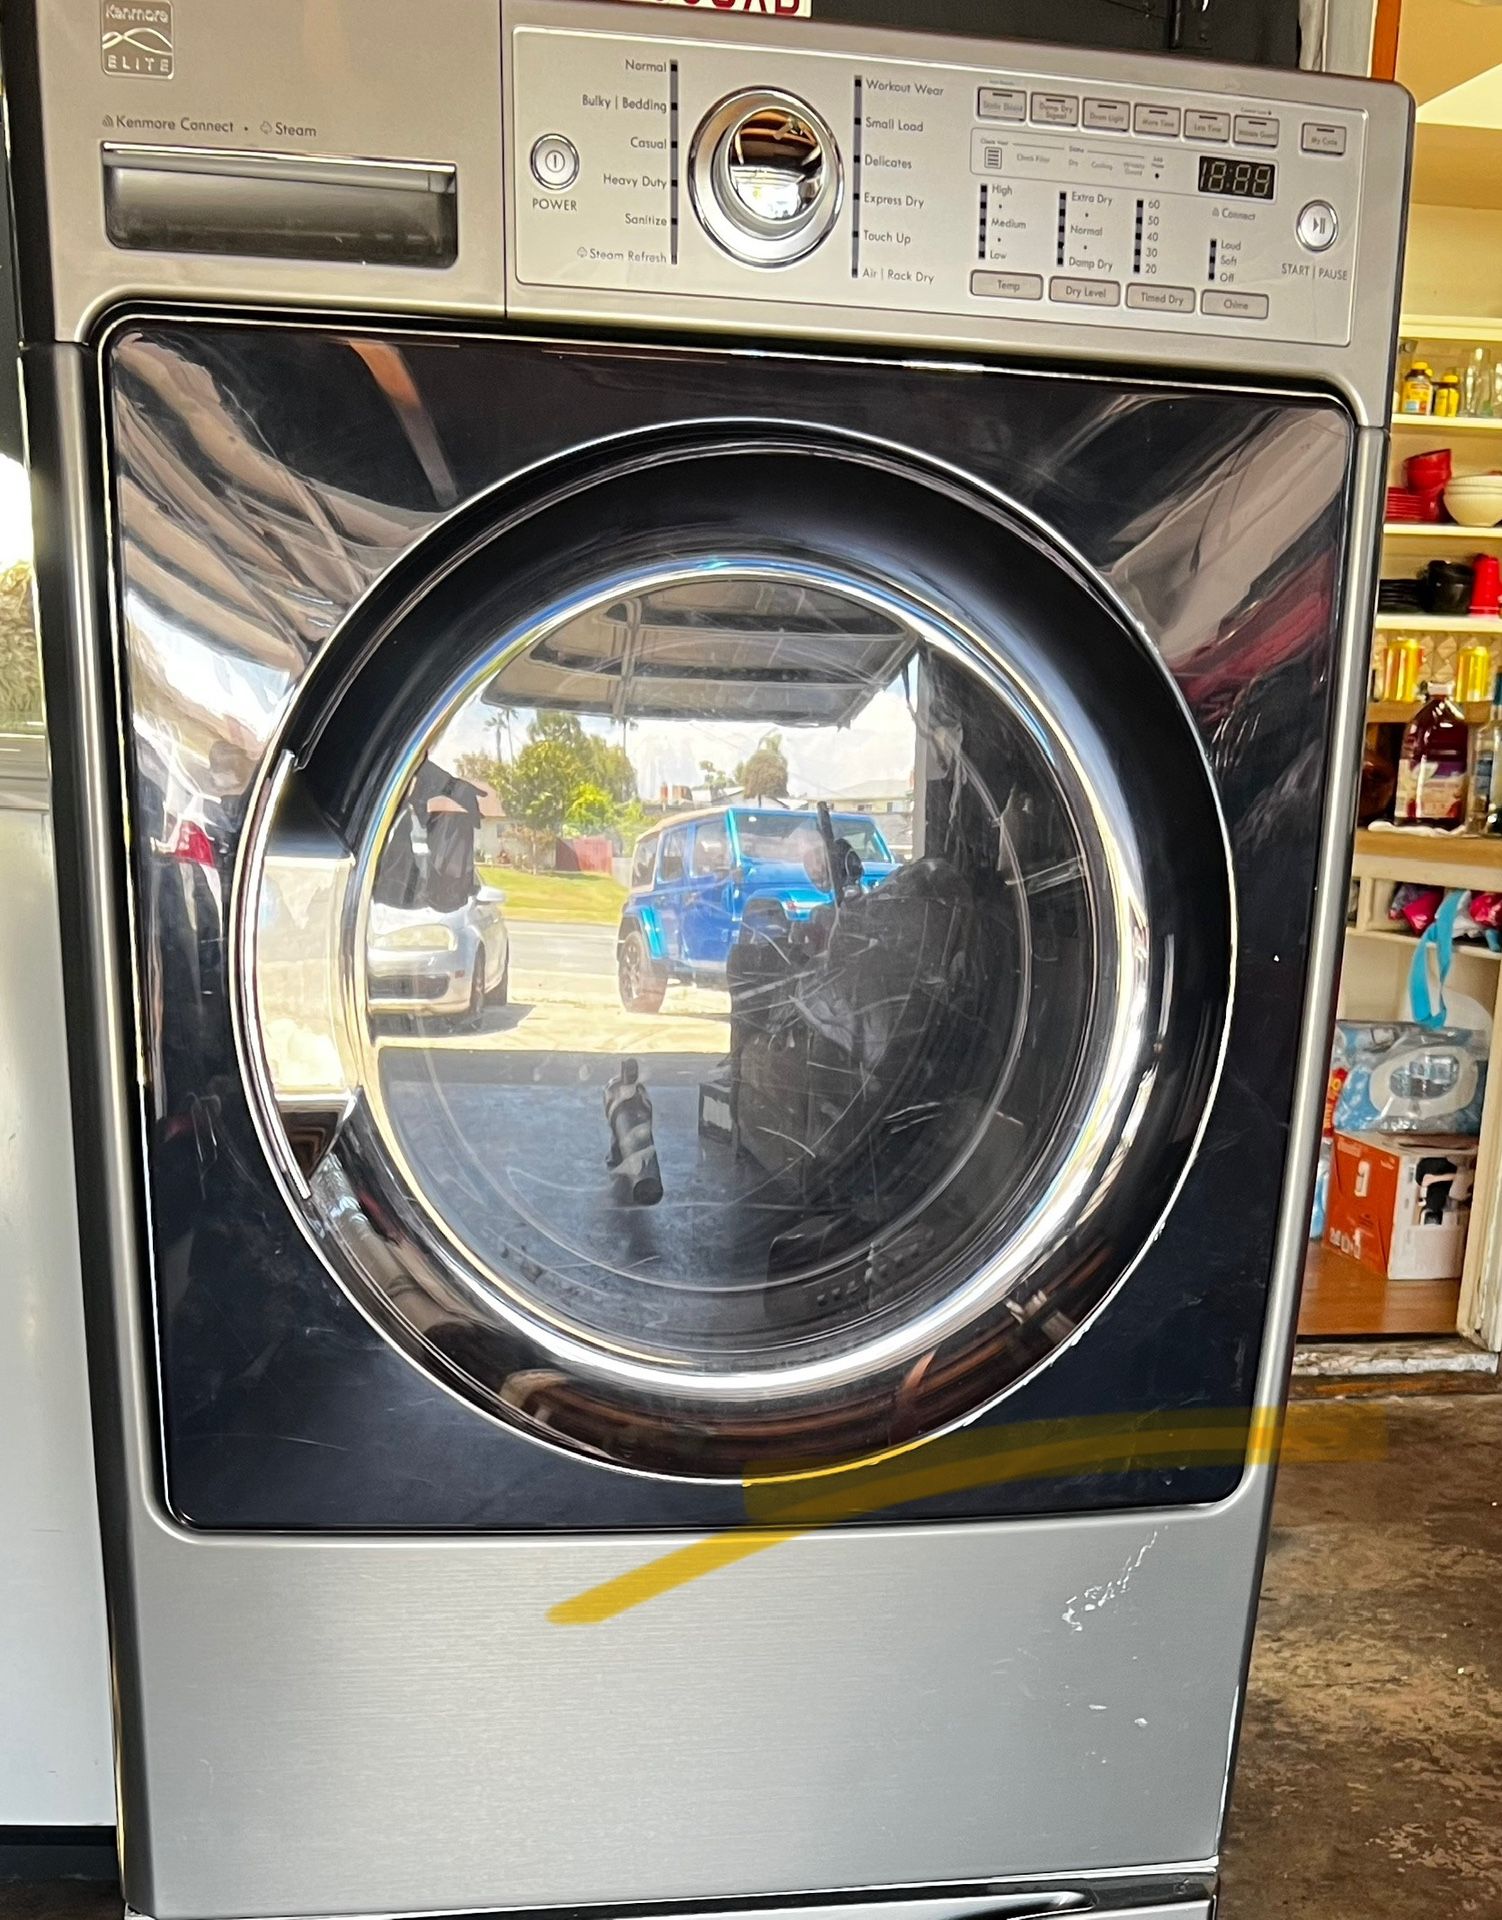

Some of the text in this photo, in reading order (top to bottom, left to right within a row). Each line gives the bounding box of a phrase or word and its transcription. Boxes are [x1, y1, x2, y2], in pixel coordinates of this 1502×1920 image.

[107, 55, 169, 73] ELITE
[625, 59, 667, 72] Normal
[866, 78, 944, 96] Workout Wear
[582, 94, 611, 109] Bulky
[622, 97, 667, 114] Bedding
[116, 115, 317, 137] Kenmore Connect Steam
[866, 116, 924, 132] Small Load
[630, 137, 667, 150] Casual
[865, 154, 912, 169] Delicates
[603, 173, 667, 189] Heavy Duty
[992, 183, 1013, 196] High
[532, 198, 578, 212] POWER
[864, 192, 924, 209] Express Dry
[1071, 191, 1113, 207] Extra Dry
[1147, 200, 1161, 210] 60
[625, 213, 667, 226] Sanitize
[991, 219, 1026, 229] Medium
[1147, 216, 1160, 226] 50
[1070, 225, 1103, 236] Normal
[1146, 232, 1159, 242] 40
[864, 230, 911, 246] Touch Up
[1221, 240, 1242, 251] Loud
[589, 248, 667, 263] Steam Refresh
[990, 251, 1007, 260] Low
[1145, 248, 1158, 258] 30
[1069, 257, 1113, 272] Damp Dry
[1220, 255, 1237, 266] Soft
[1145, 264, 1157, 274] 20
[1281, 263, 1309, 276] START
[1318, 267, 1348, 281] PAUSE
[862, 268, 877, 278] Air
[887, 269, 912, 281] Rack
[916, 271, 935, 285] Dry
[1220, 272, 1235, 282] Off
[997, 280, 1021, 293] Temp
[1065, 286, 1107, 299] Dry Level
[1140, 291, 1184, 306] Timed Dry
